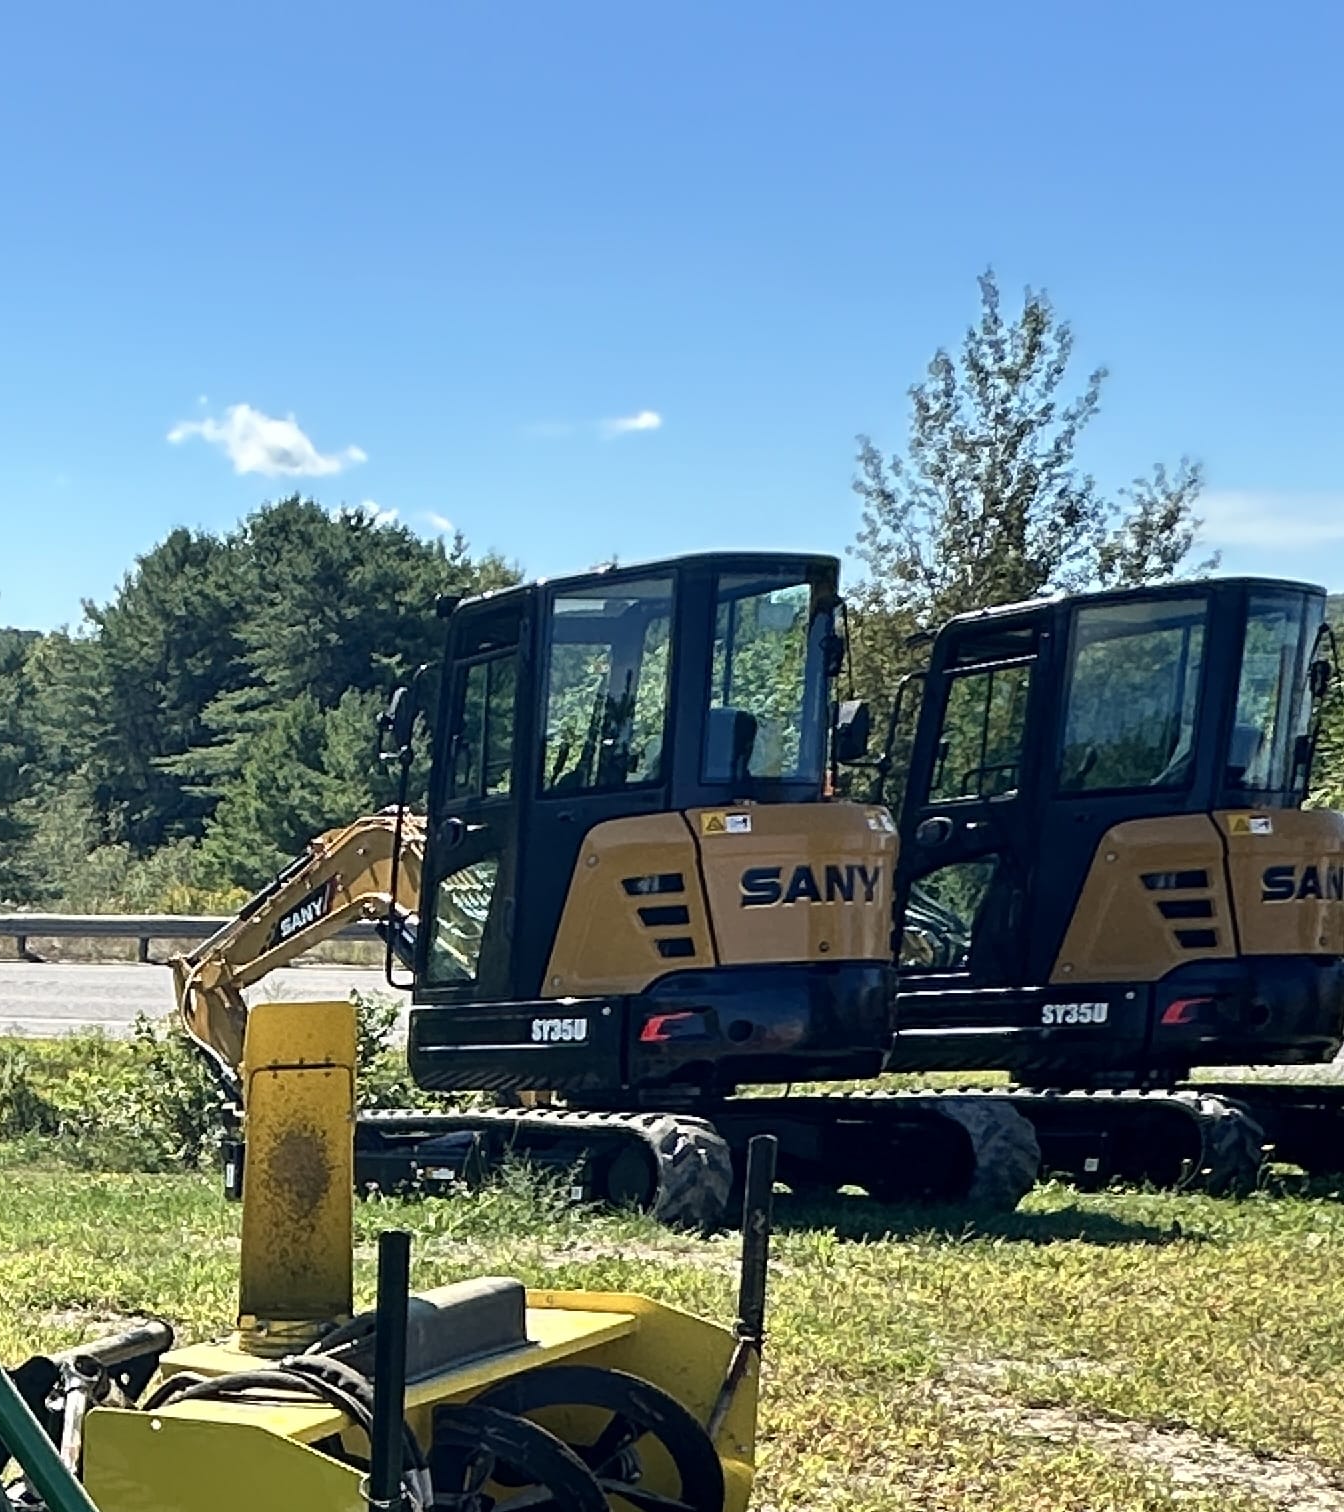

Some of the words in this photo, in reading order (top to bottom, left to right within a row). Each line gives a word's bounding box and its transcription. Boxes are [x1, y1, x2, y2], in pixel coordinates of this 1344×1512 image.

[741, 864, 880, 907] SANY
[1262, 865, 1344, 902] SAN
[280, 896, 323, 937] SANY
[531, 1018, 587, 1041] SY35U
[1041, 1003, 1109, 1024] SY35U
